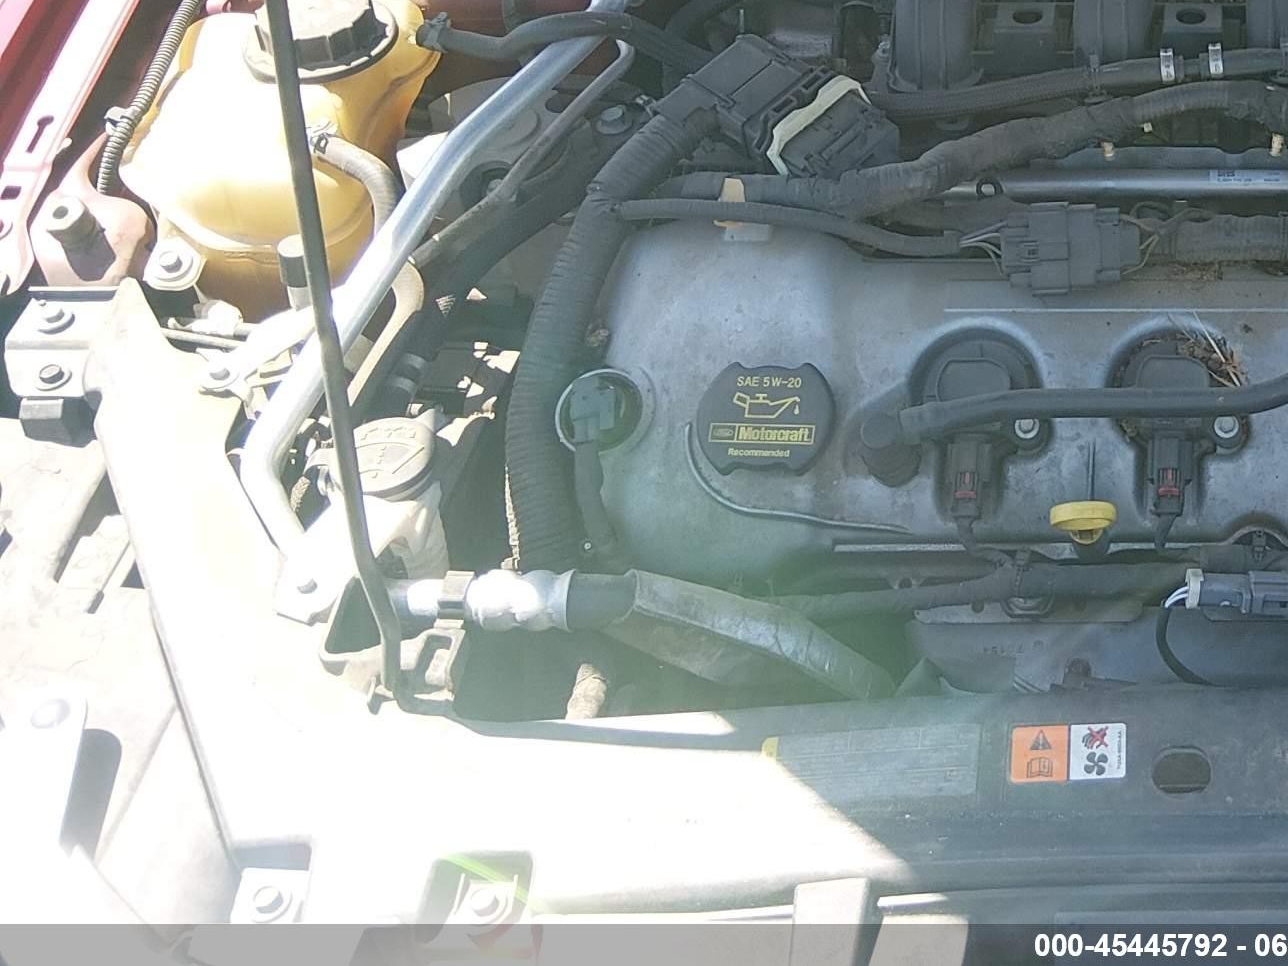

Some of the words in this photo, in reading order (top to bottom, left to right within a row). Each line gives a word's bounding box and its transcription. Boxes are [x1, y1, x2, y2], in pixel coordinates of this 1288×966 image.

[736, 376, 759, 387] SAE
[738, 426, 811, 443] Motorcraft
[727, 447, 790, 458] Recommended
